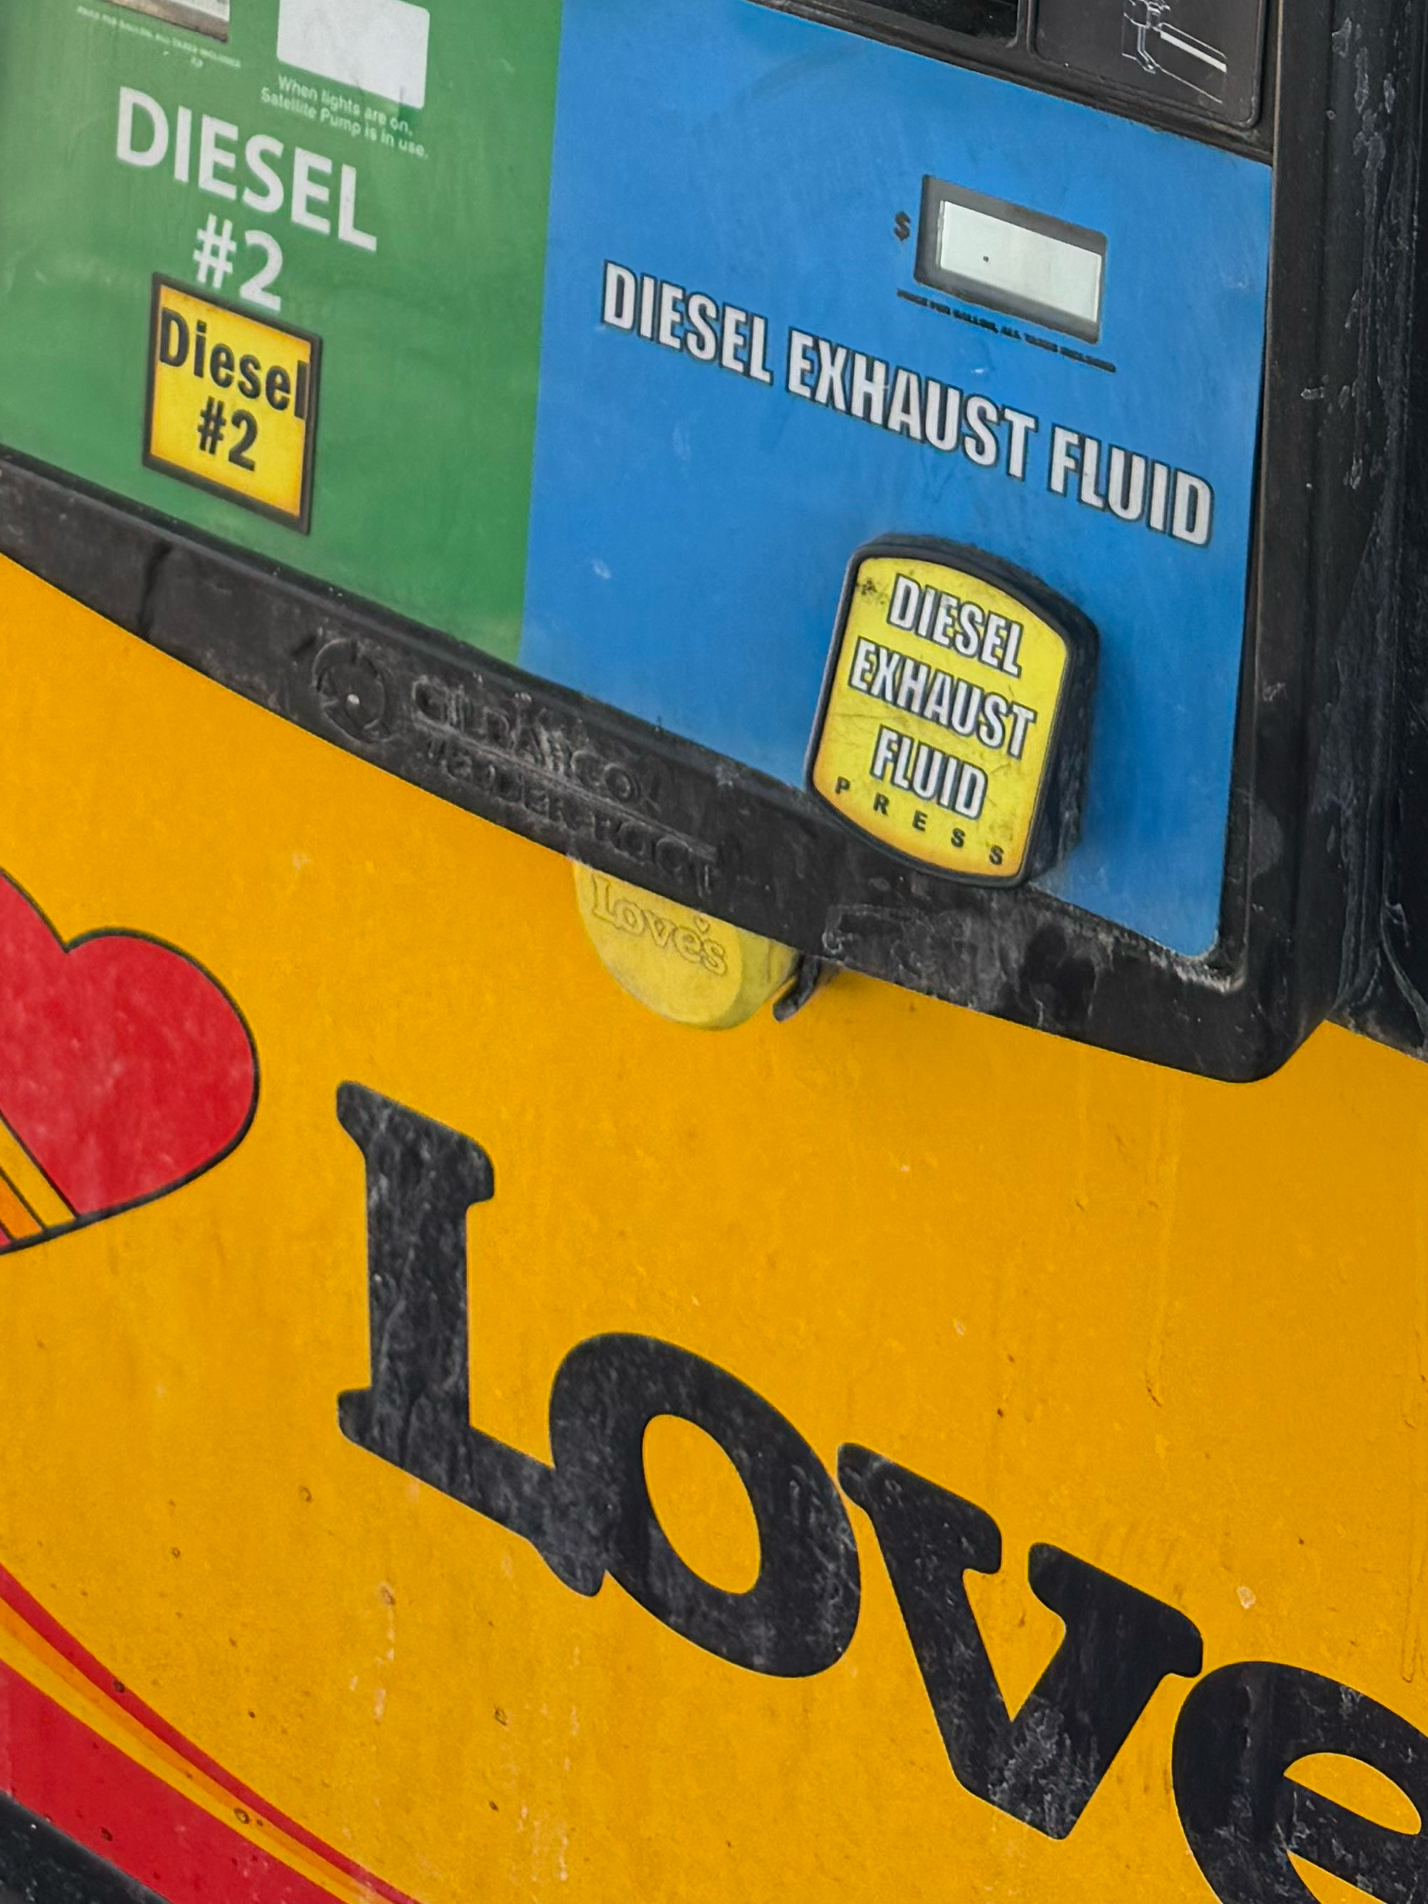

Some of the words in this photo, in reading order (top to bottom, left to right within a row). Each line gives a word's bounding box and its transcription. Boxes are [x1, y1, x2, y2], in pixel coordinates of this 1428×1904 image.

[115, 86, 378, 253] DIESEL
[192, 213, 283, 312] #2
[158, 305, 310, 422] Diesel
[600, 259, 772, 384] DIESEL
[785, 327, 1037, 480] EXHAUST
[1048, 423, 1215, 548] FLUID
[197, 399, 259, 473] #2
[887, 573, 1024, 679] DIESEL
[848, 637, 1037, 760] EXHAUST
[870, 725, 989, 821] FLUID
